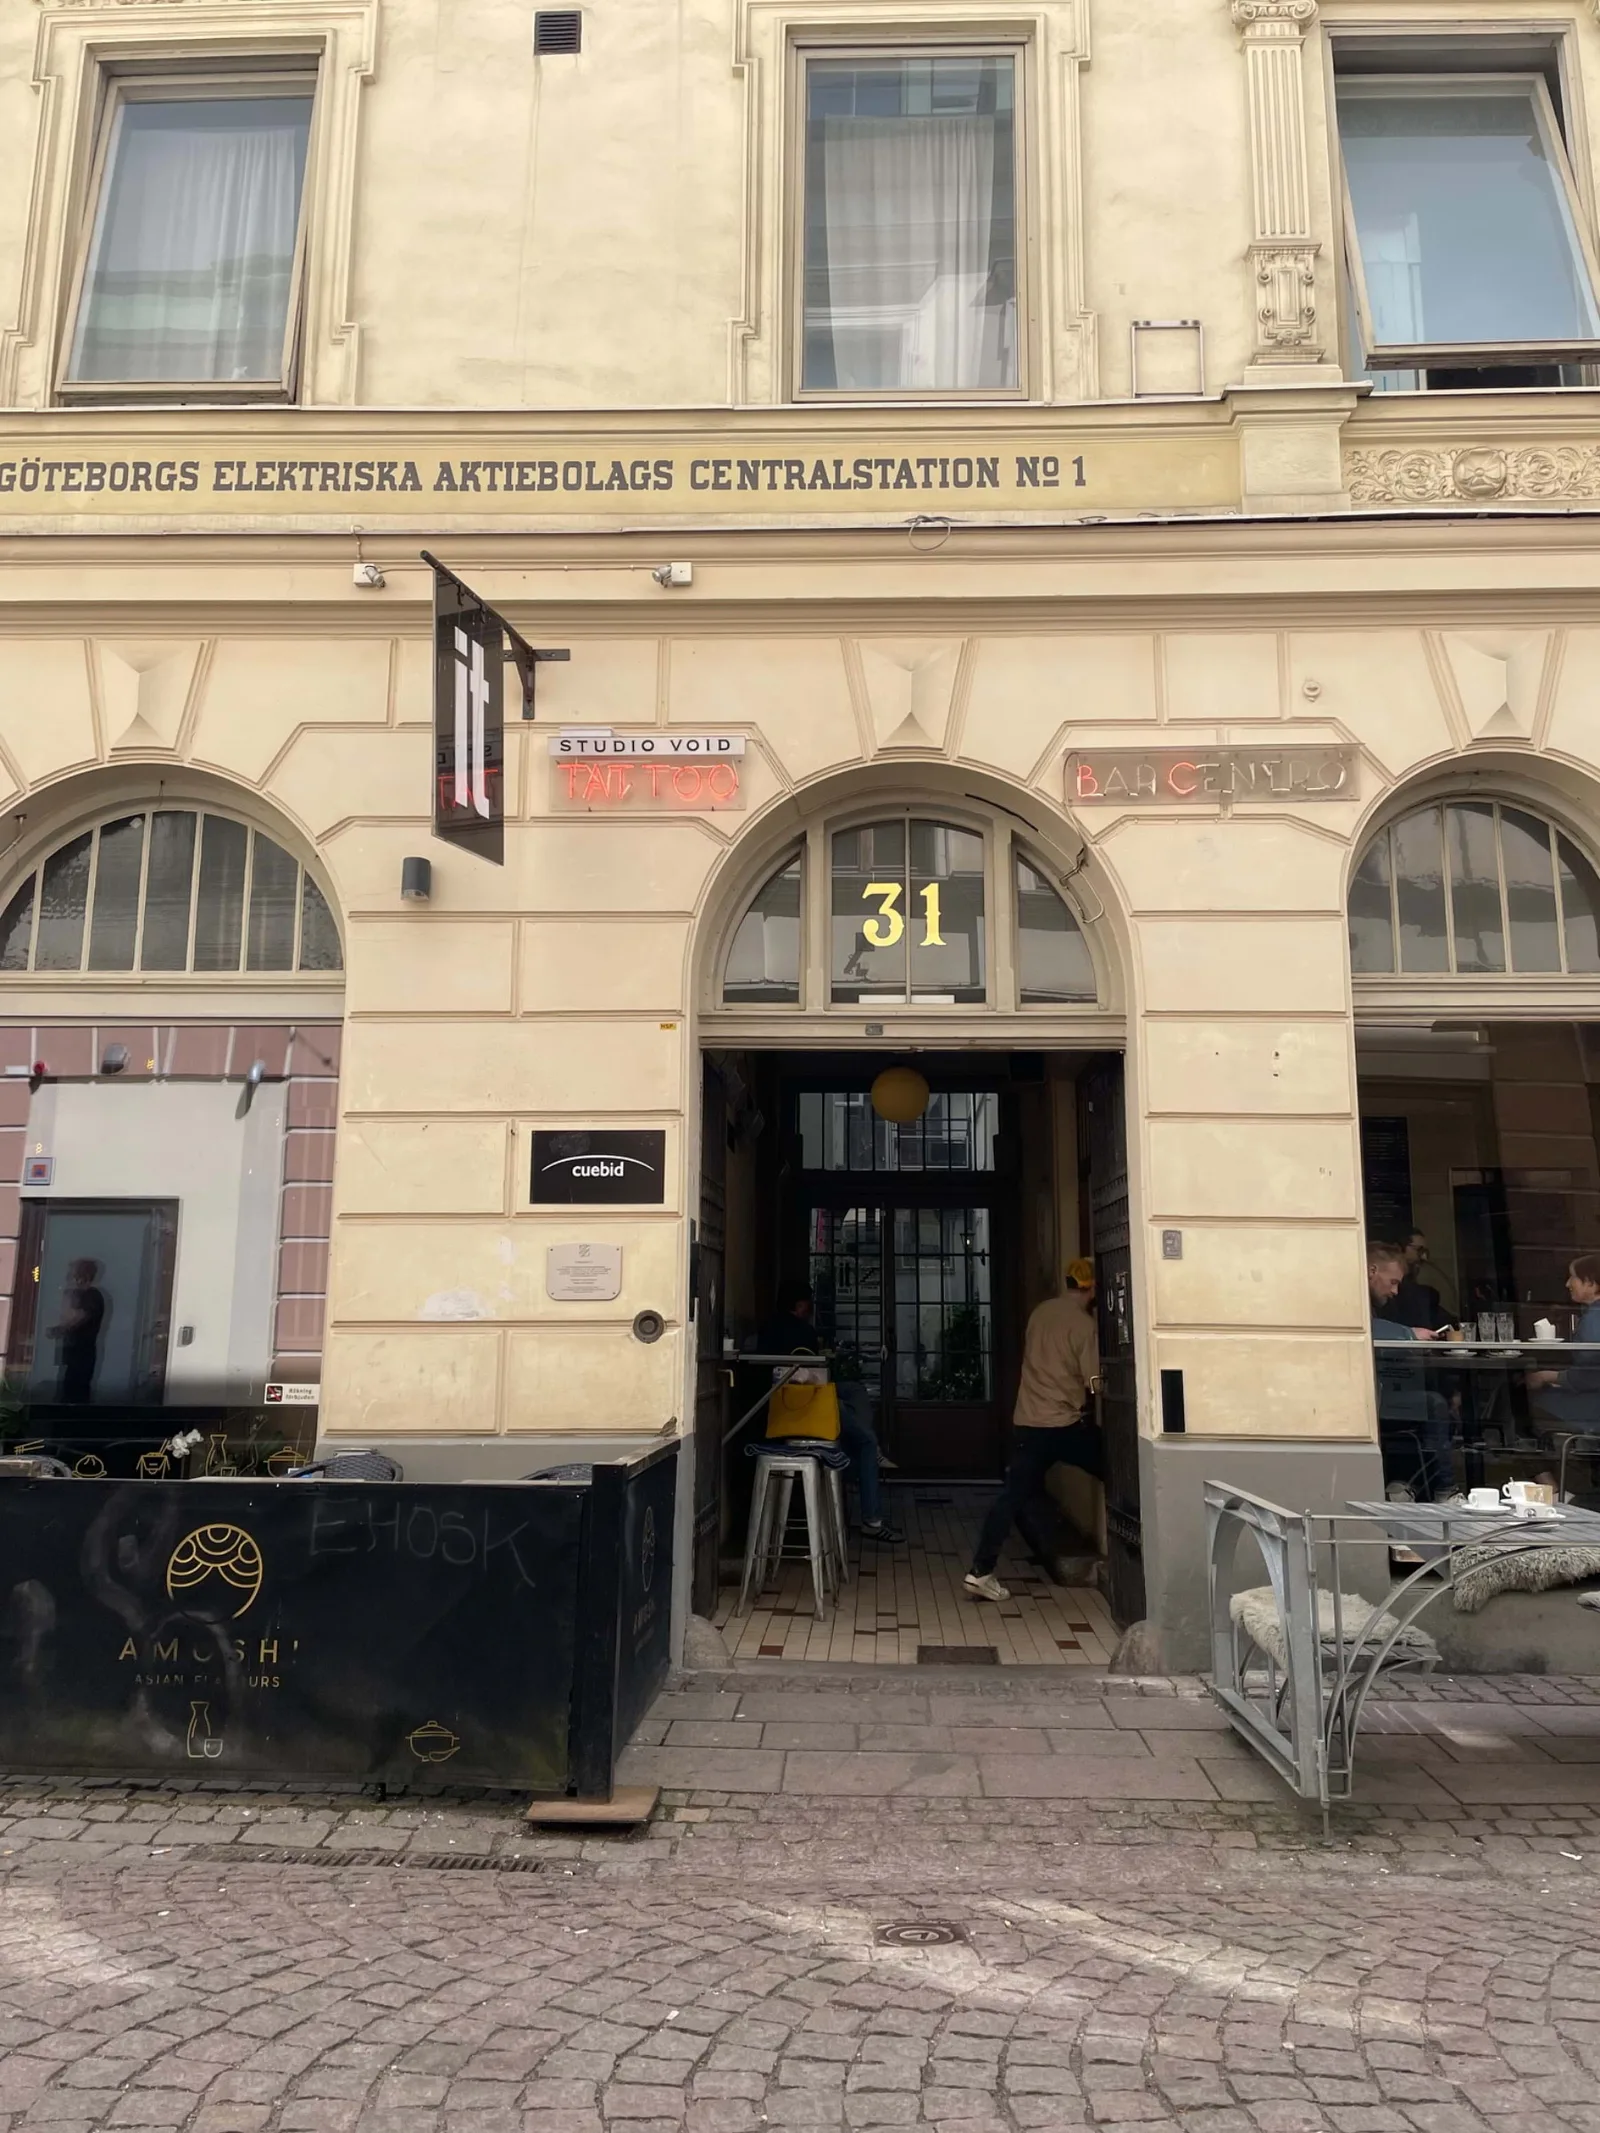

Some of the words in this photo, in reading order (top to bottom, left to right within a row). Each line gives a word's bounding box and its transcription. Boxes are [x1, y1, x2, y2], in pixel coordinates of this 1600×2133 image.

[0, 457, 201, 493] GÖTEBORGS
[212, 460, 423, 492] ELEKTRISKA
[433, 460, 673, 492] AKTIEBOLAGS
[690, 457, 1000, 491] CENTRALSTATION
[1071, 455, 1087, 487] 1
[454, 625, 490, 820] it
[560, 739, 655, 753] STUDIO
[670, 737, 732, 752] VOID
[556, 762, 739, 802] TATTOO
[1076, 763, 1157, 798] BAR
[1168, 760, 1347, 795] CENTRO
[862, 882, 947, 947] 31
[572, 1161, 625, 1178] cuebid
[135, 1674, 184, 1686] ASIAN
